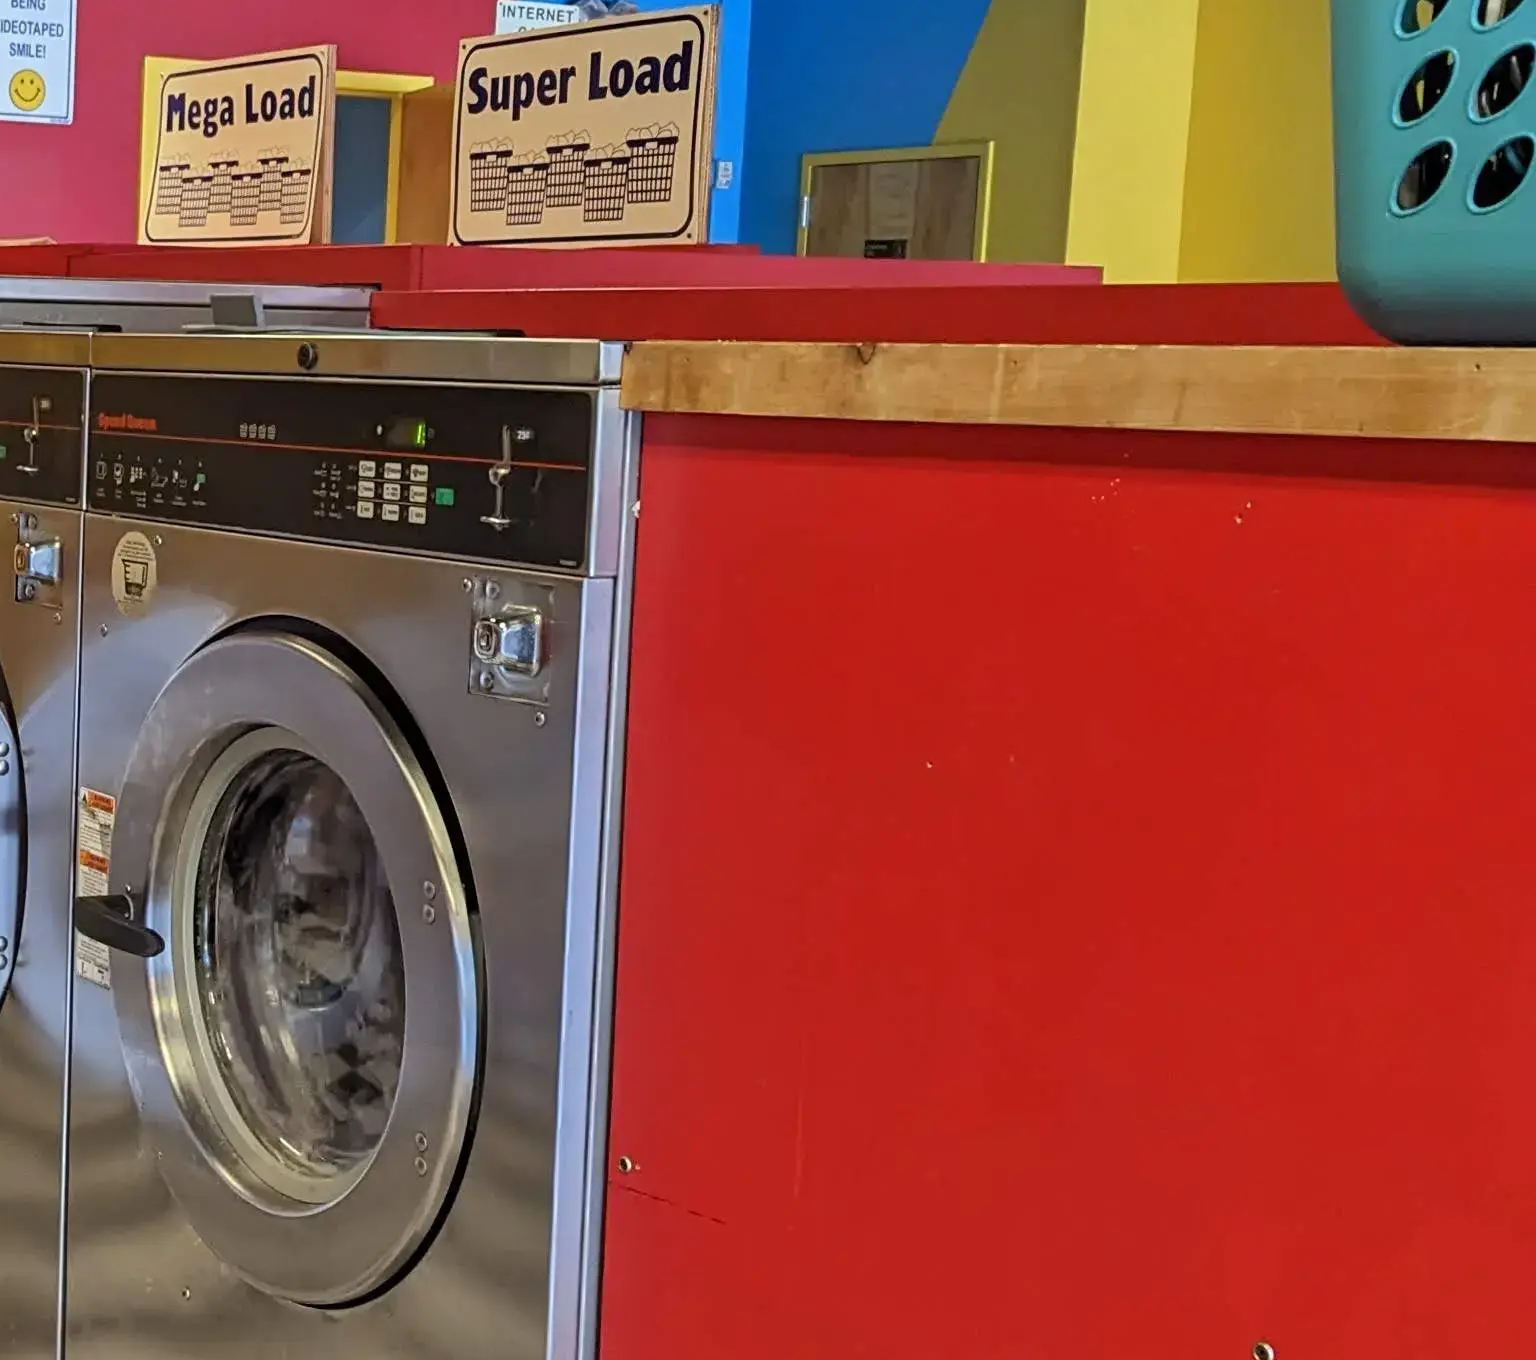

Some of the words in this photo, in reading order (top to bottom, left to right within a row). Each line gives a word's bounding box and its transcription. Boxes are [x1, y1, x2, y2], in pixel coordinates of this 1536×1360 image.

[502, 4, 575, 23] INTERNET
[9, 42, 46, 58] SMILE!
[467, 66, 577, 121] Super
[588, 40, 694, 101] Load
[166, 92, 234, 138] Mega
[245, 75, 316, 124] Load
